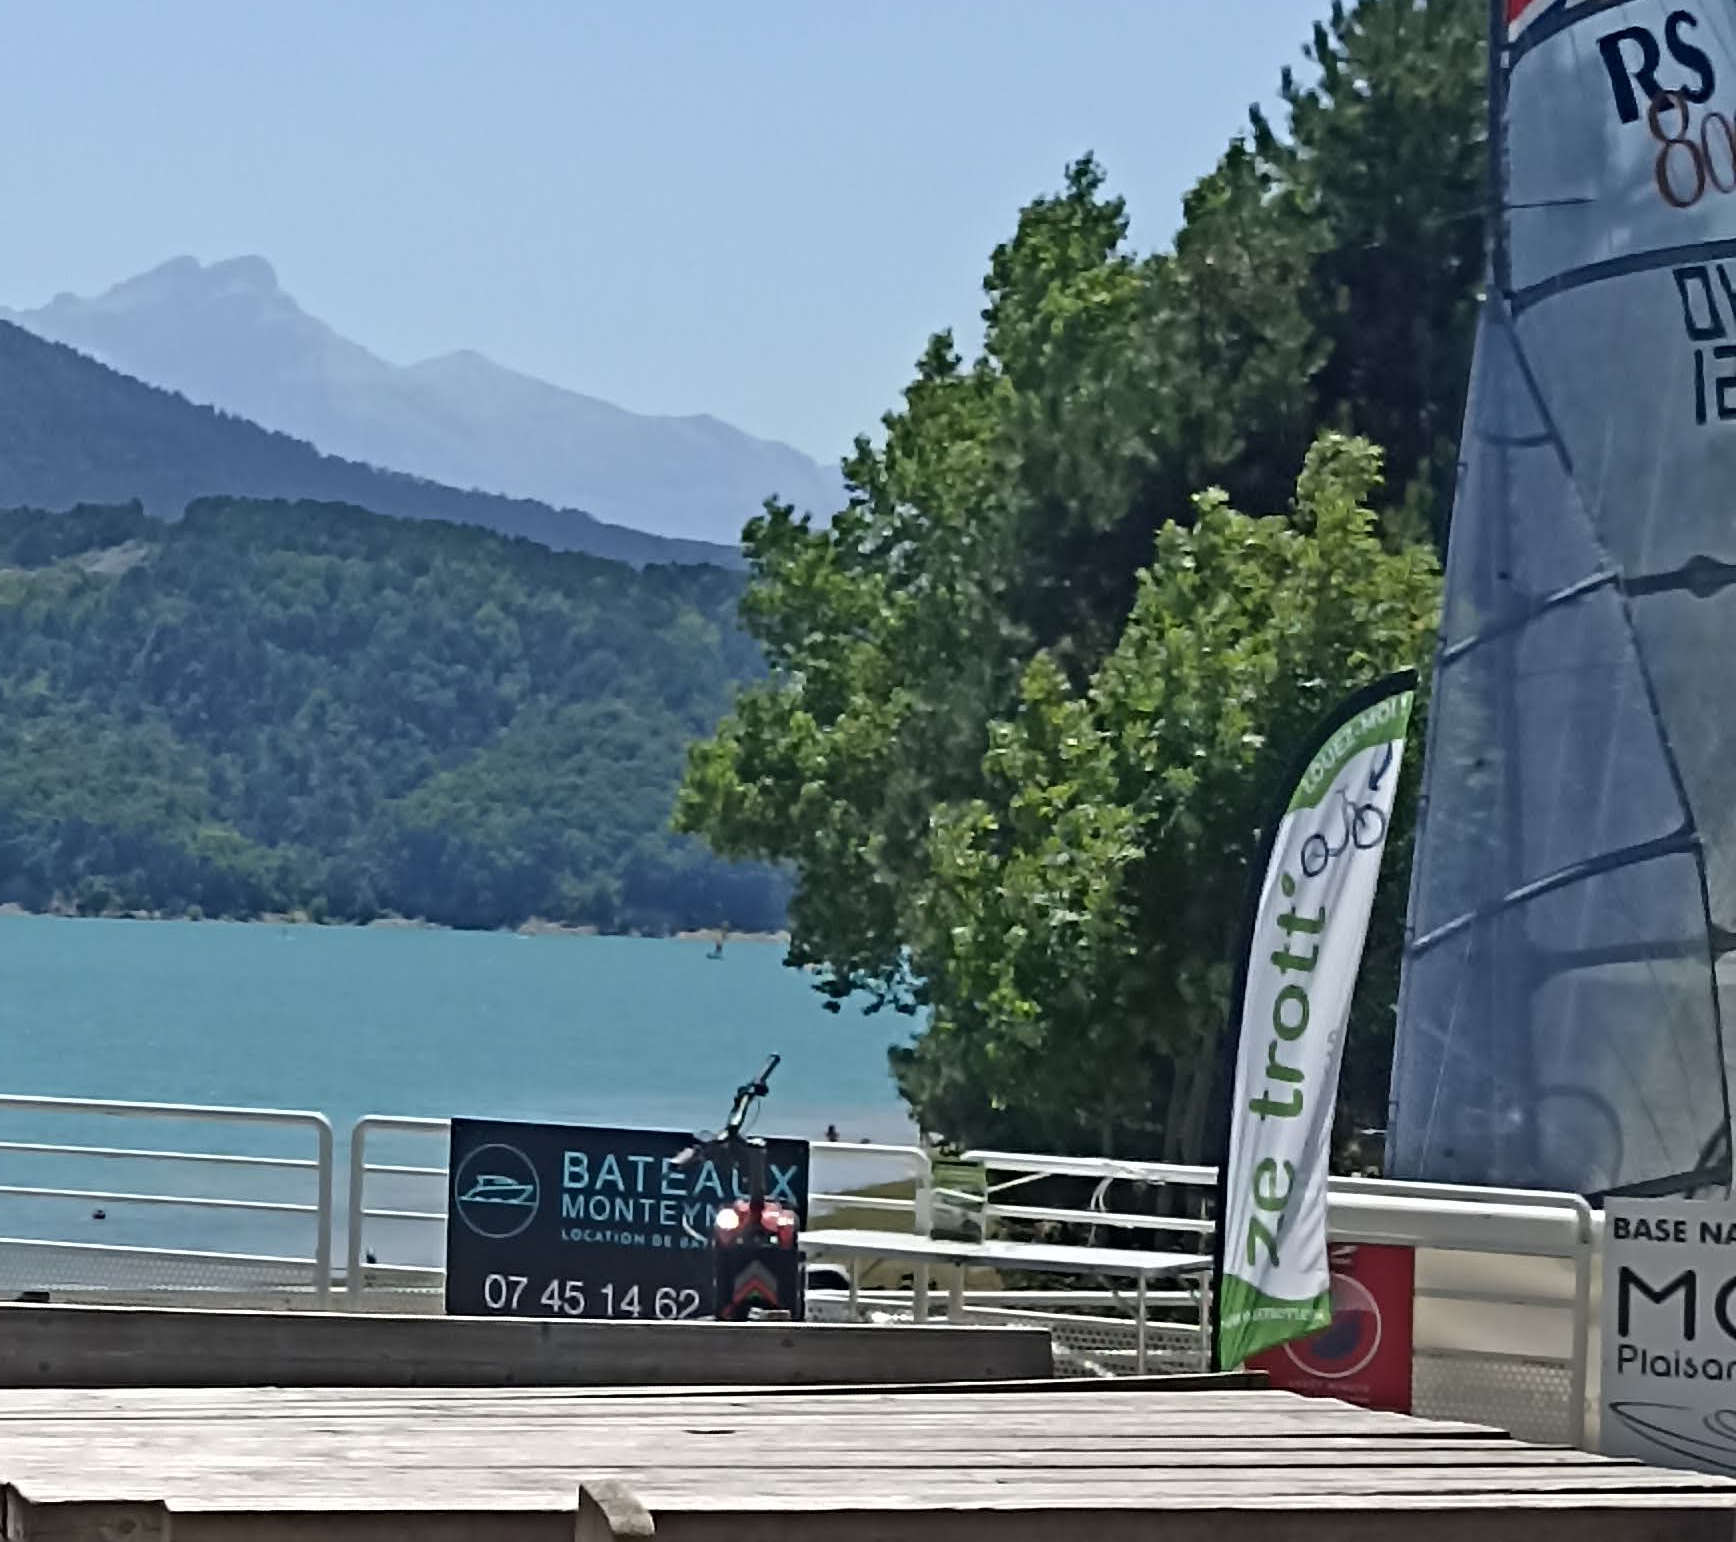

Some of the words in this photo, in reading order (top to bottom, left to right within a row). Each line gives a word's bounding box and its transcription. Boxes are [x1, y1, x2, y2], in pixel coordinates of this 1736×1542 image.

[1596, 10, 1715, 125] RS
[1647, 88, 1736, 209] 80
[562, 1228, 646, 1245] LOCATION
[652, 1234, 672, 1248] DE
[1614, 1217, 1687, 1243] BASE
[484, 1273, 528, 1310] 07
[540, 1278, 586, 1316] 45
[600, 1282, 642, 1318] 14
[654, 1287, 701, 1320] 62
